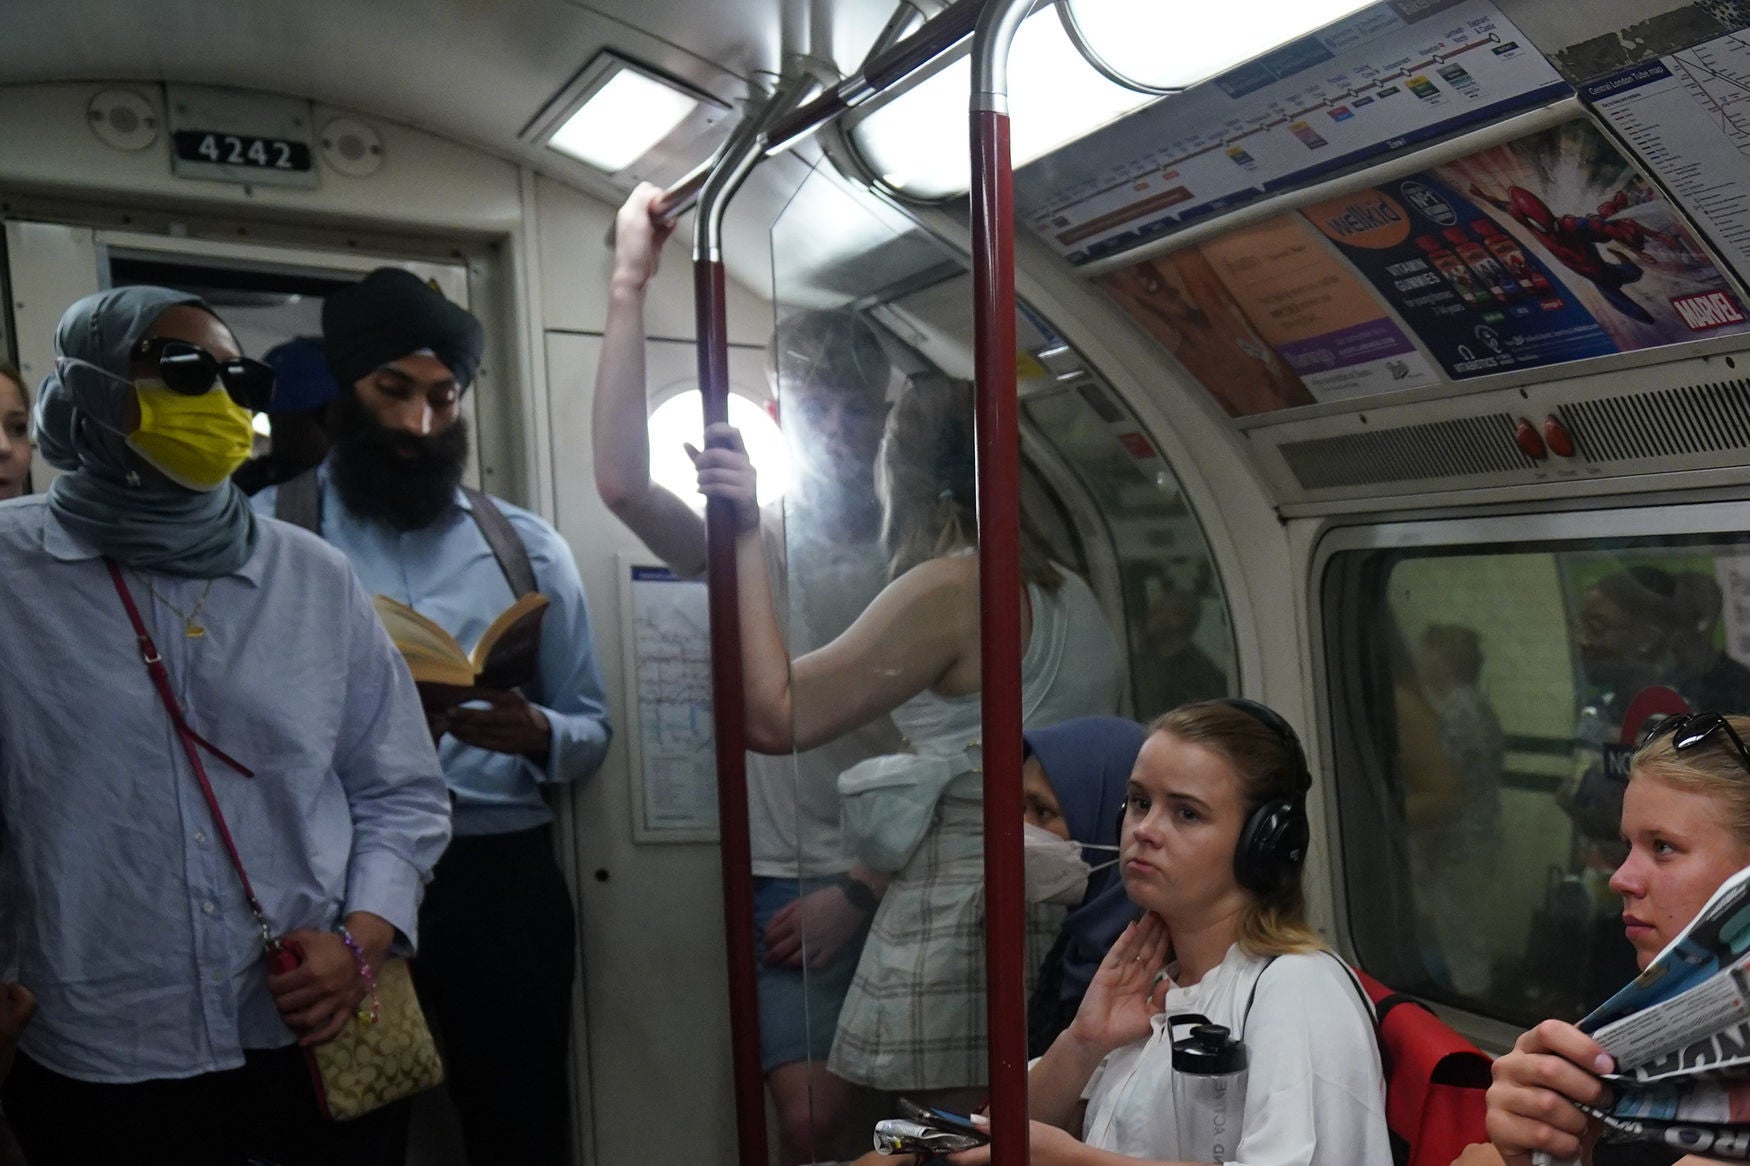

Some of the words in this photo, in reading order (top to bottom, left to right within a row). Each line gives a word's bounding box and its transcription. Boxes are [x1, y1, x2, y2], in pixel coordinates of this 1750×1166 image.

[1587, 81, 1612, 95] Central
[1609, 74, 1633, 88] London
[1631, 69, 1649, 80] Tube
[1647, 65, 1664, 76] map
[198, 134, 294, 170] 4242
[1327, 203, 1402, 236] wellkid
[1673, 292, 1744, 329] MARVEL
